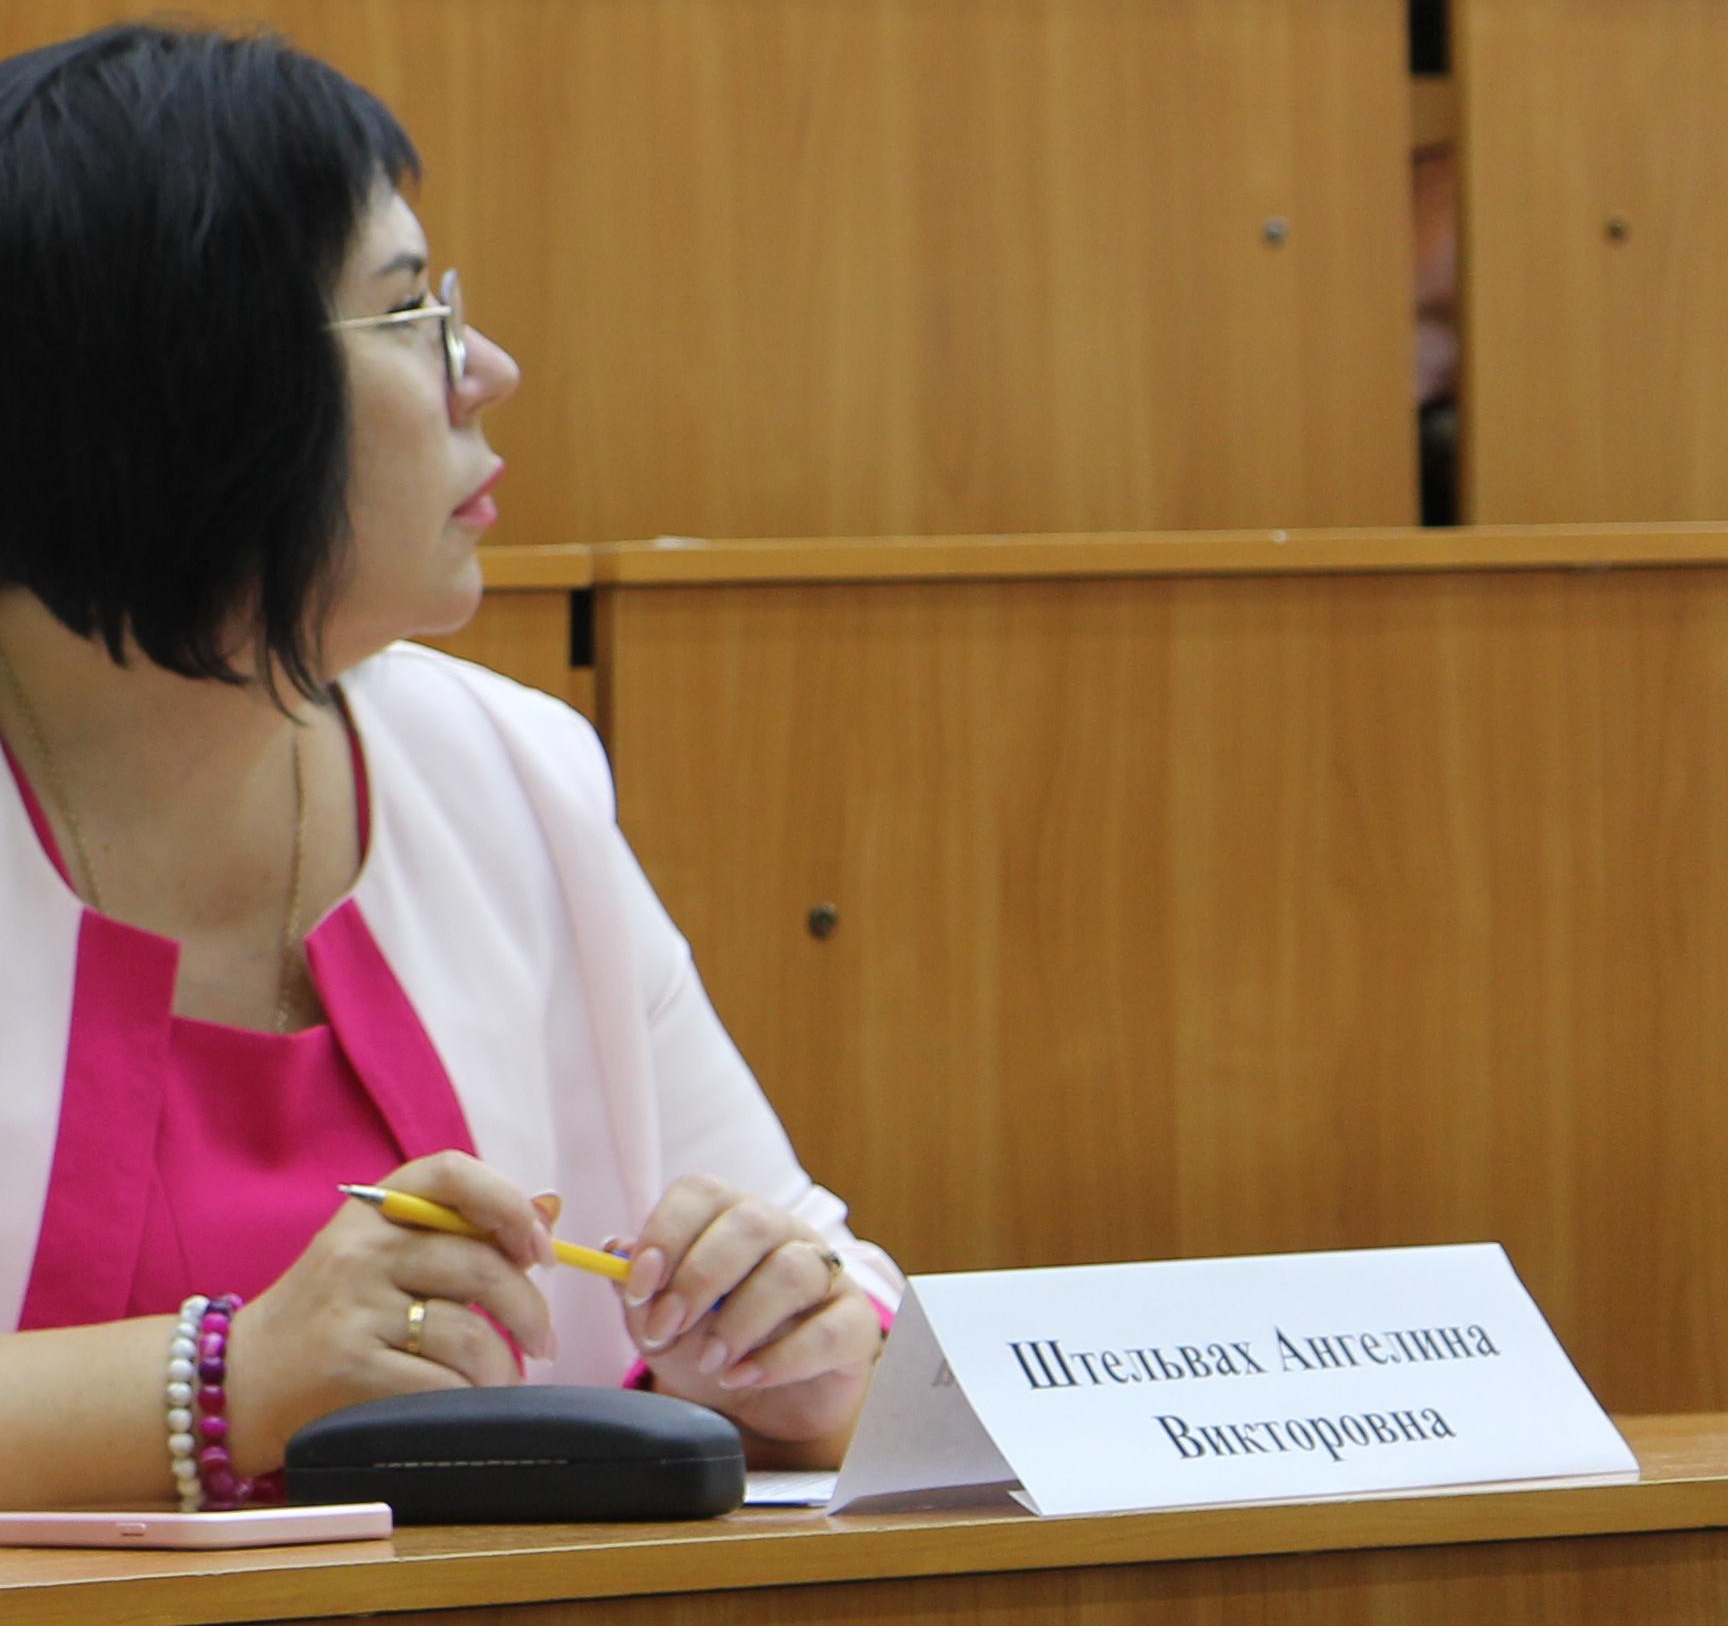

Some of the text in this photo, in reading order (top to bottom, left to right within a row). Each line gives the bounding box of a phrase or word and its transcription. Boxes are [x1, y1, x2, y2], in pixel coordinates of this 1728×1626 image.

[1007, 1324, 1502, 1390] Штельвах Ангелина
[1155, 1404, 1457, 1462] Викторовна
